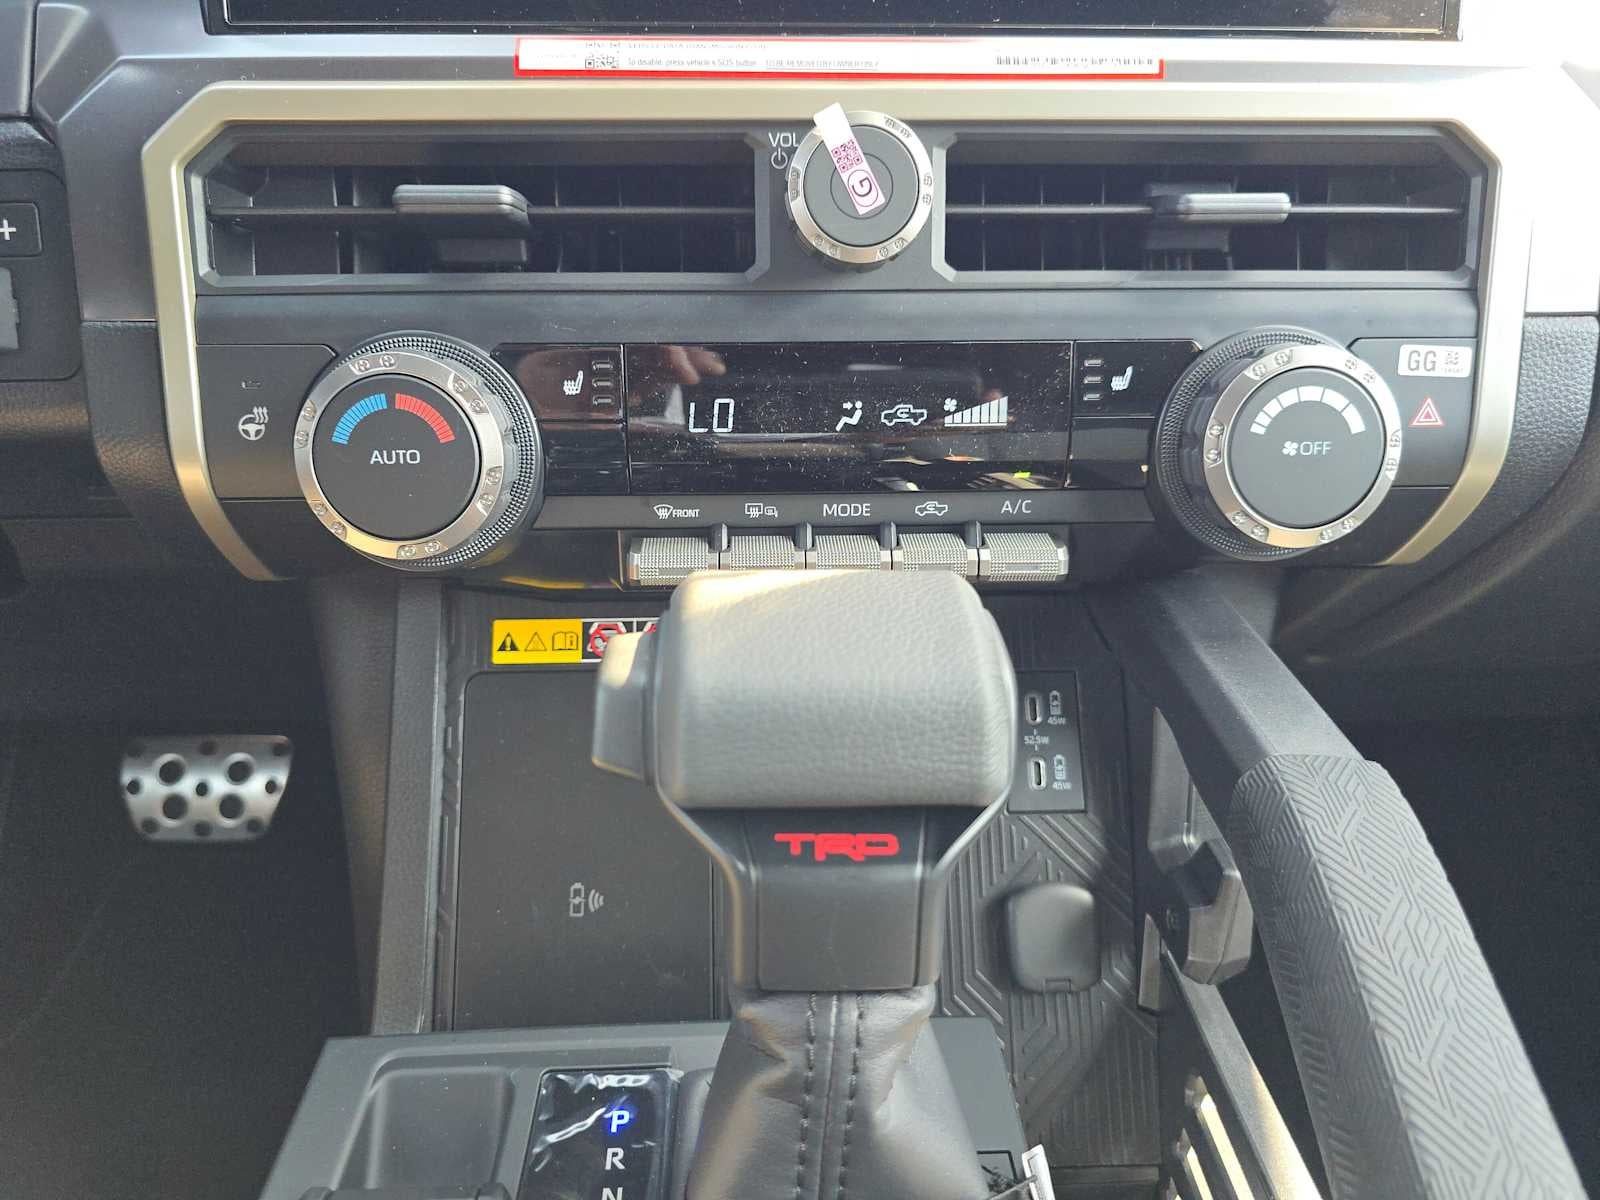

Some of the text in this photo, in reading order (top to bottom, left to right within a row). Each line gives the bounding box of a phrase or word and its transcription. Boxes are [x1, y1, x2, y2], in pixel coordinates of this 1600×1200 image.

[768, 132, 799, 148] VOL
[851, 176, 873, 198] G
[1407, 349, 1437, 373] GG
[688, 398, 735, 433] LO
[1299, 441, 1332, 456] OFF
[369, 449, 421, 465] AUTO
[672, 508, 700, 518] FRONT
[822, 503, 871, 517] MODE
[1000, 499, 1032, 515] A/C
[1047, 716, 1066, 725] 45W
[1052, 781, 1072, 790] 45W
[774, 833, 899, 862] TRD
[610, 1110, 630, 1133] P
[604, 1147, 626, 1171] R
[601, 1187, 624, 1200] N
